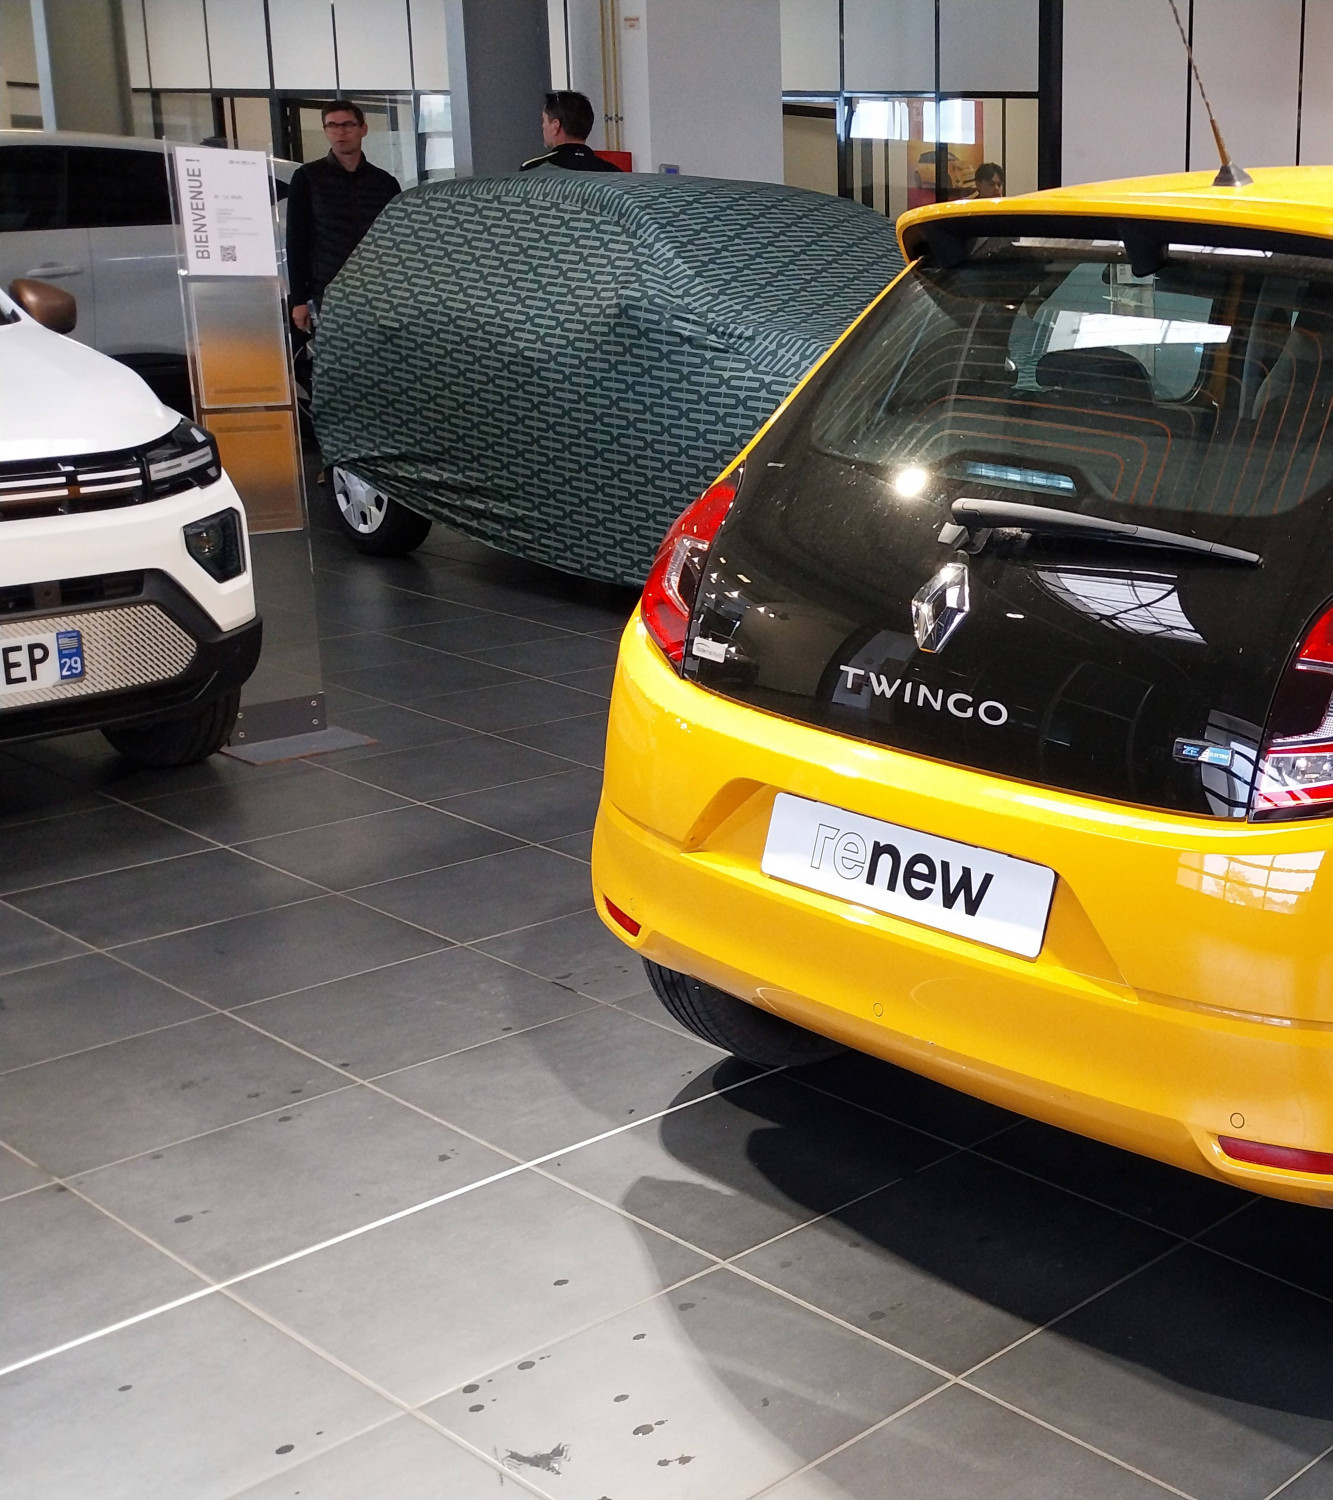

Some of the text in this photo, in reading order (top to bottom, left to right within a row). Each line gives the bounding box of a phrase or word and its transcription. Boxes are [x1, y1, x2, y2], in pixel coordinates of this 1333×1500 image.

[186, 167, 211, 260] BIENVENUE
[1, 642, 50, 686] EP
[60, 656, 82, 676] 29
[839, 664, 1009, 727] TWINGO
[810, 823, 995, 917] renew
